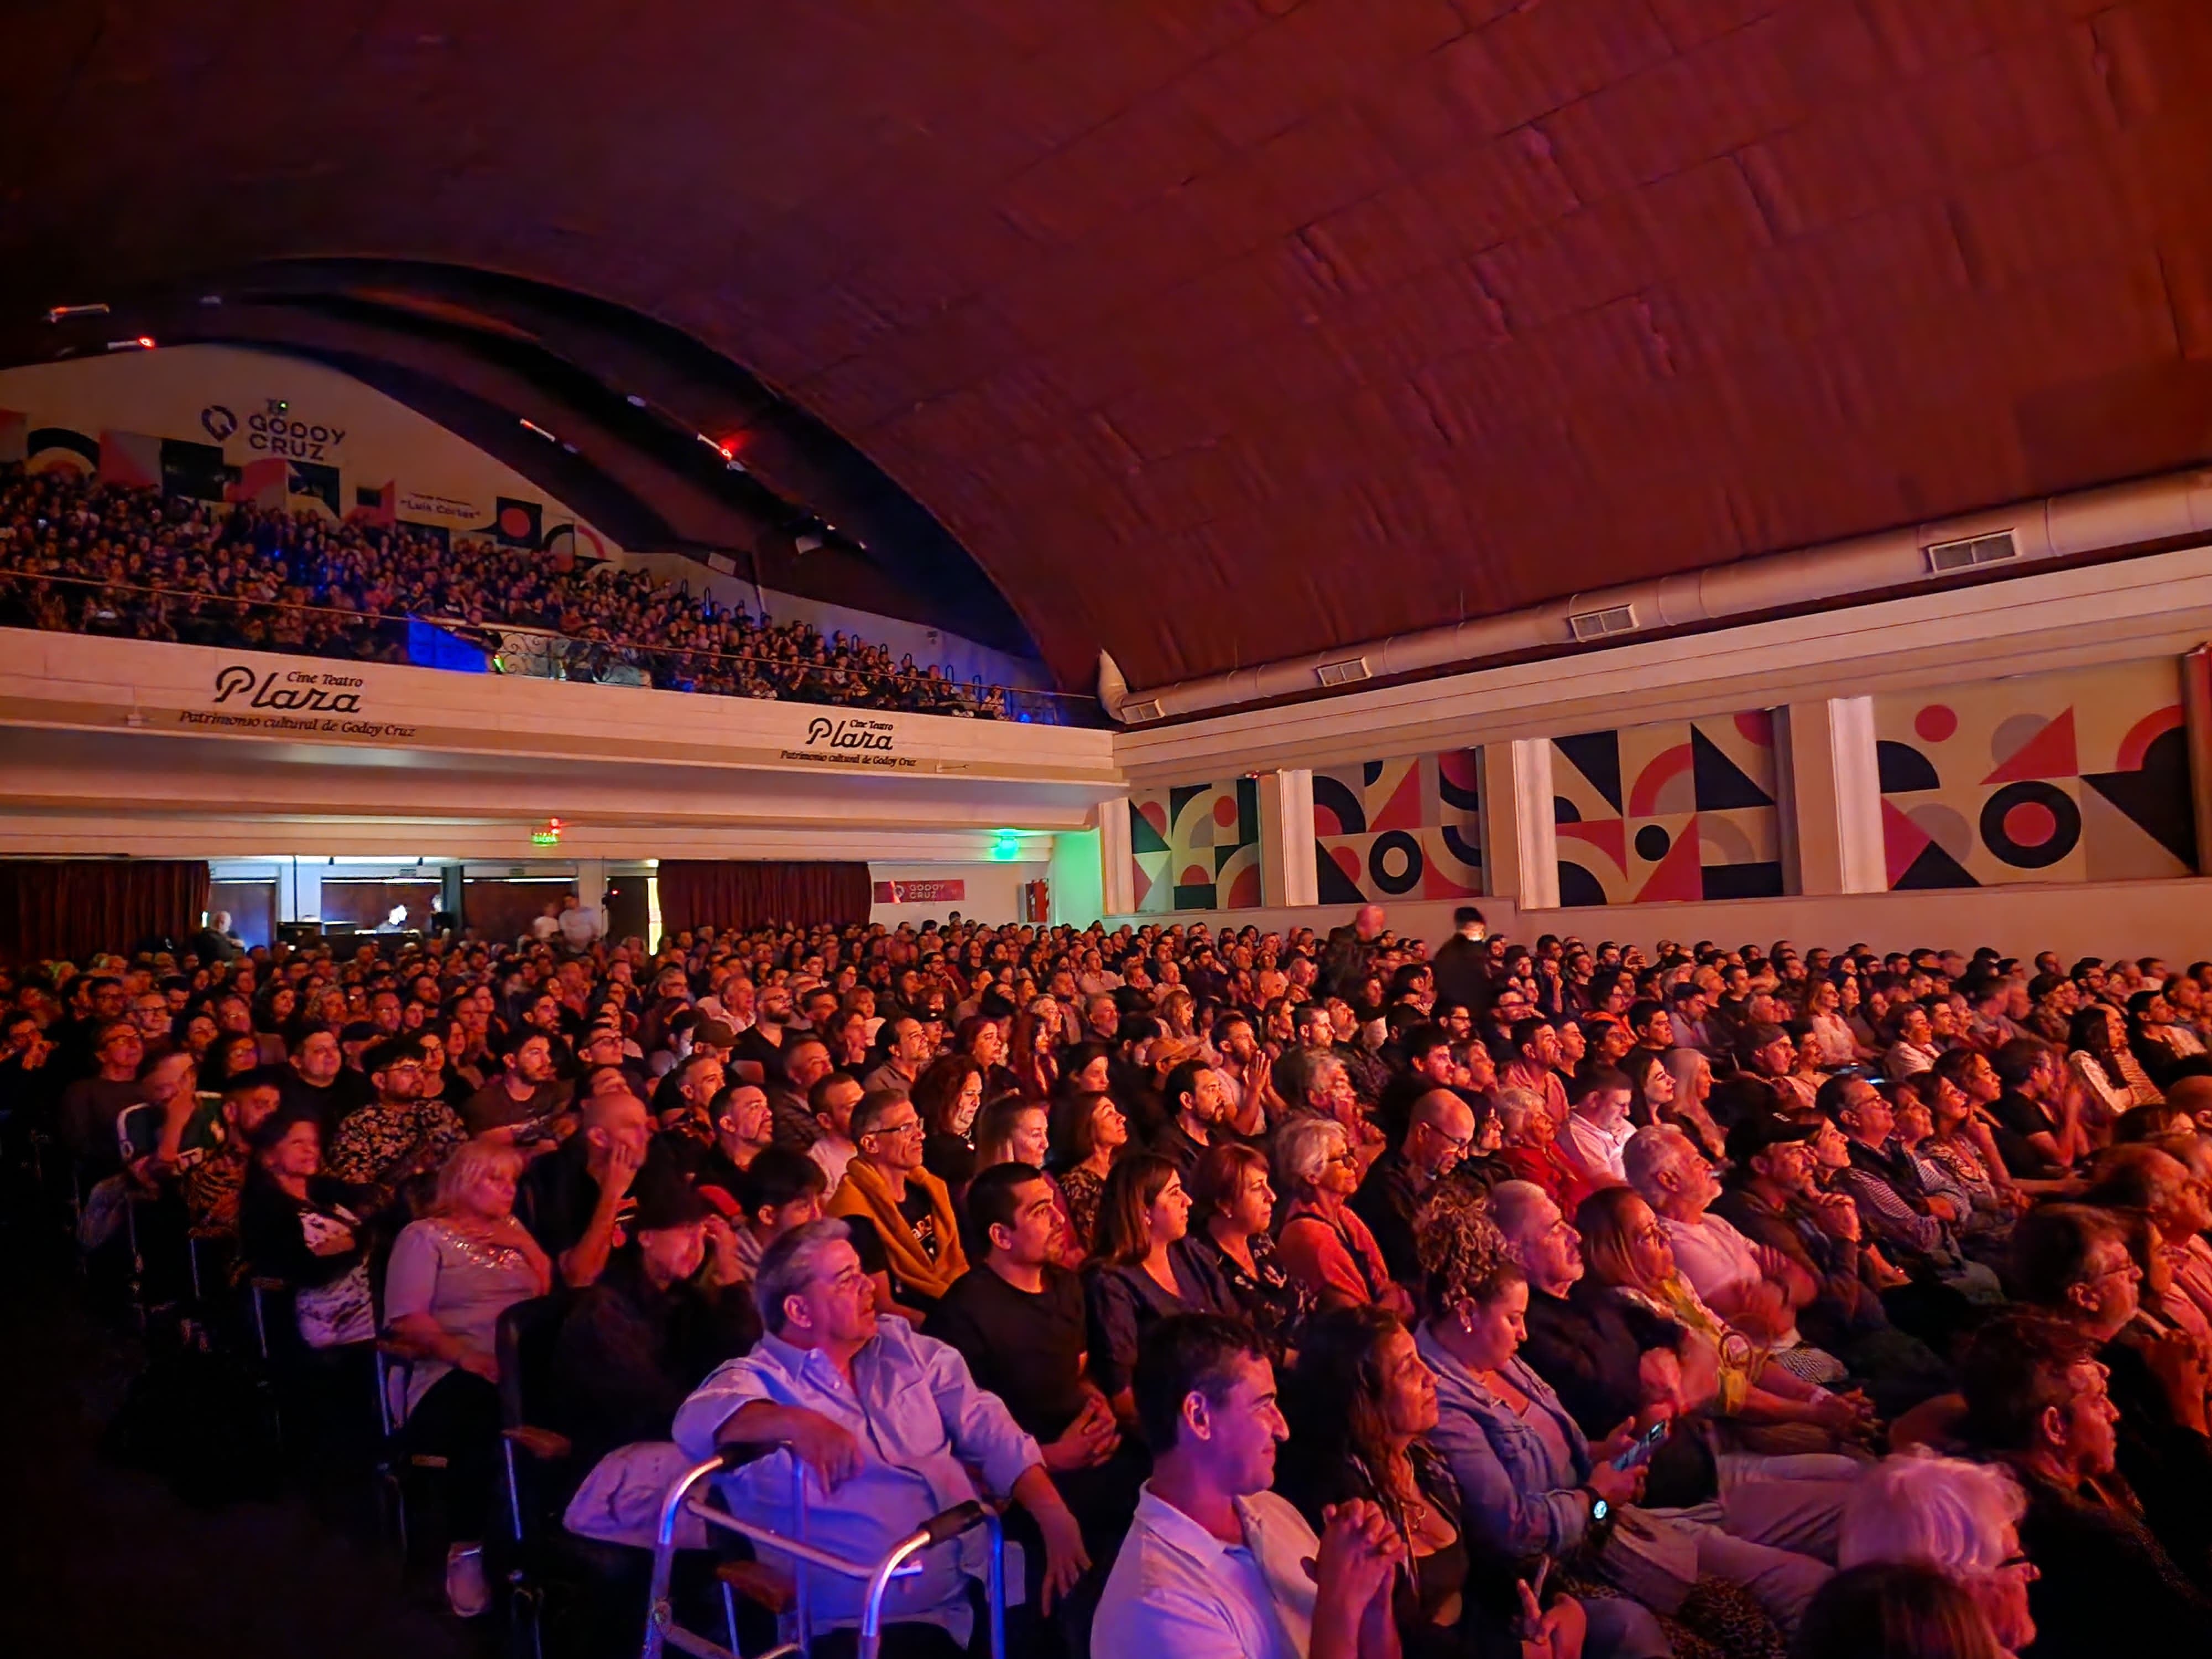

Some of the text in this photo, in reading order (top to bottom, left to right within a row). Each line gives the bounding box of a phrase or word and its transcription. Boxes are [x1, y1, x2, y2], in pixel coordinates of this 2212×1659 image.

[249, 414, 345, 445] GODOY
[249, 433, 324, 461] CRUZ
[213, 666, 361, 713] Plaza
[287, 671, 363, 687] Cine Teatro
[179, 711, 416, 737] Patrimonio cultural de Godoy Cruz
[805, 717, 894, 750] Plaza
[850, 719, 894, 731] Cine Teatro
[780, 750, 917, 767] Patrimonio cultural de Godoy Cruz
